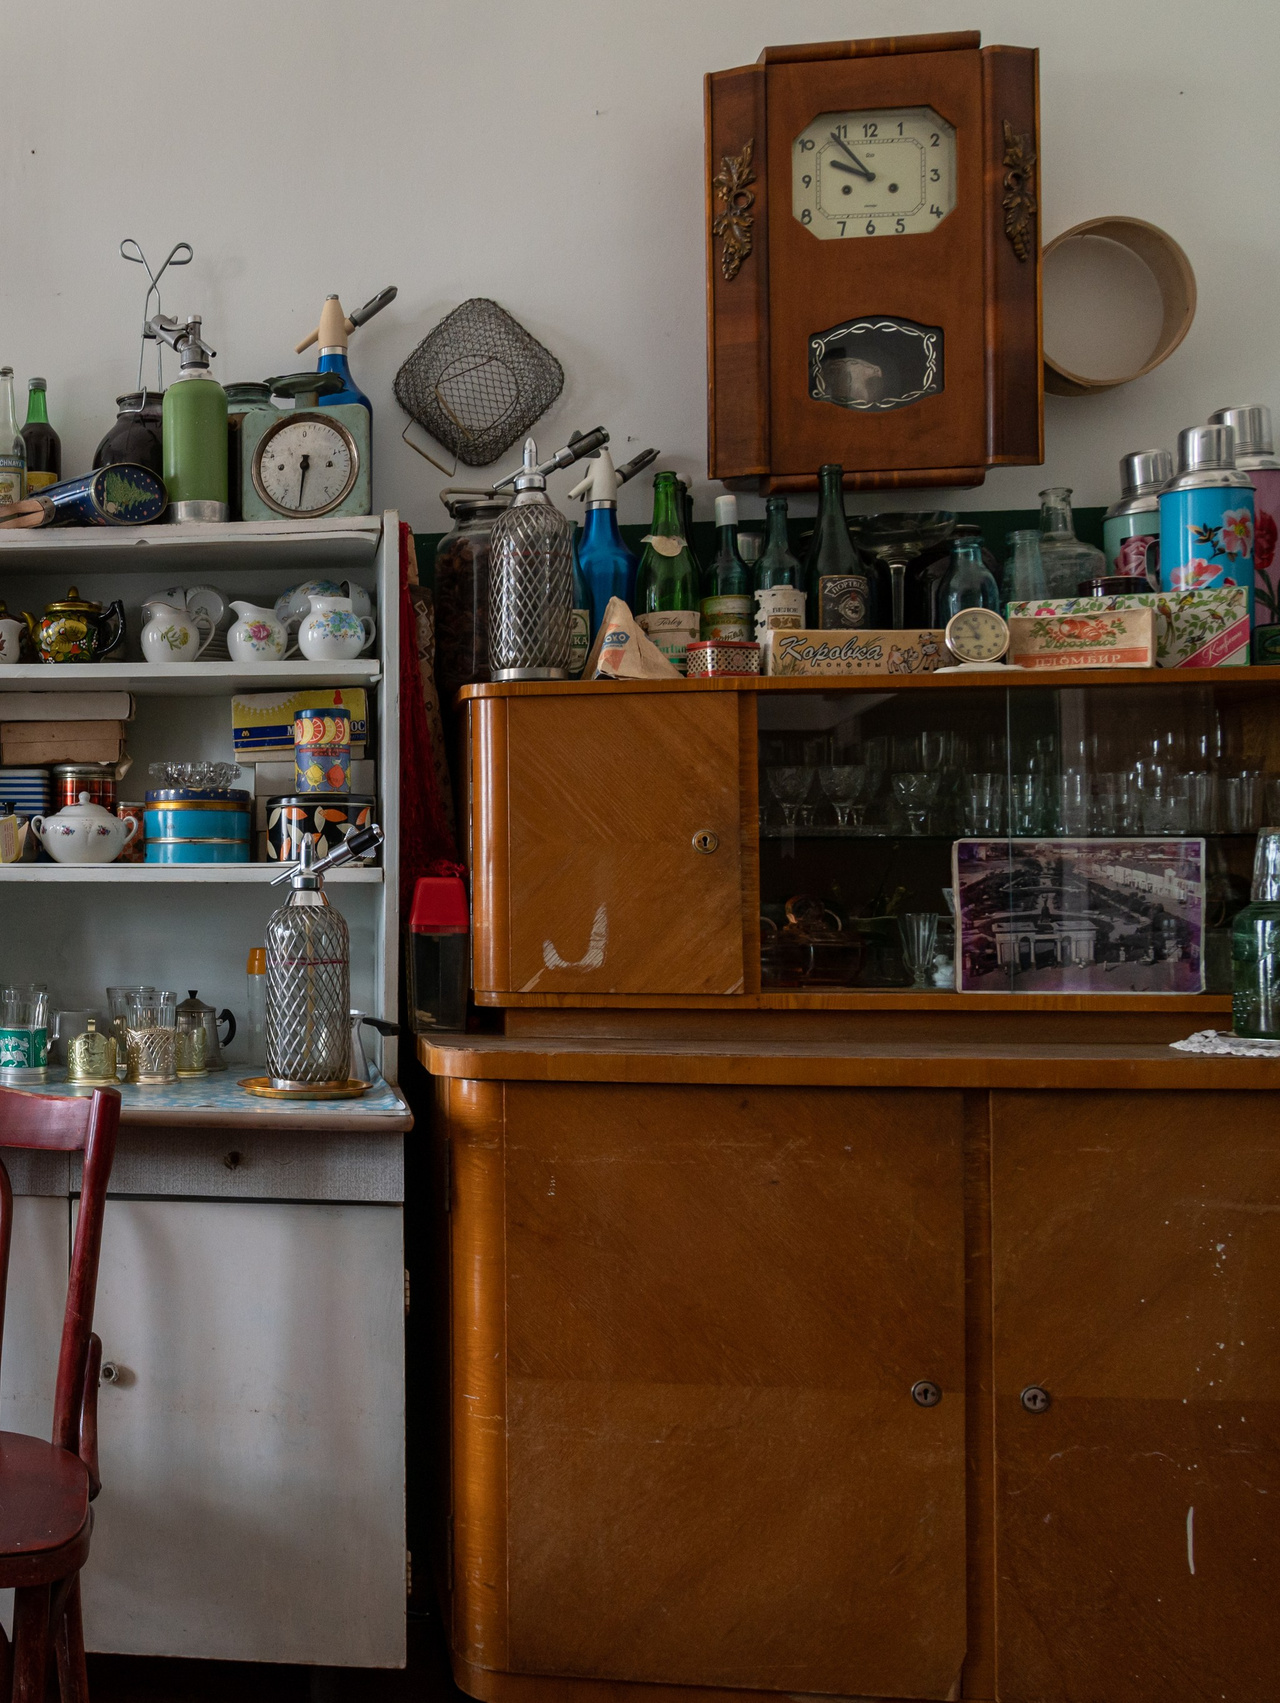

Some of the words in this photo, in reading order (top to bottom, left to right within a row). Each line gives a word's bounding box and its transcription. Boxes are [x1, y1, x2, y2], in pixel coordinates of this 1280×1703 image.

[836, 125, 848, 139] 11
[862, 123, 878, 138] 12
[897, 122, 904, 136] 1
[798, 138, 816, 153] 10
[930, 133, 940, 147] 2
[801, 174, 812, 189] 9
[930, 169, 941, 182] 3
[800, 208, 812, 225] 8
[929, 204, 944, 219] 4
[836, 221, 847, 237] 7
[865, 219, 876, 235] 6
[895, 218, 906, 234] 5
[780, 636, 884, 667] Коровка
[817, 661, 882, 669] конфеты
[1036, 654, 1121, 667] ПЛОМБИР
